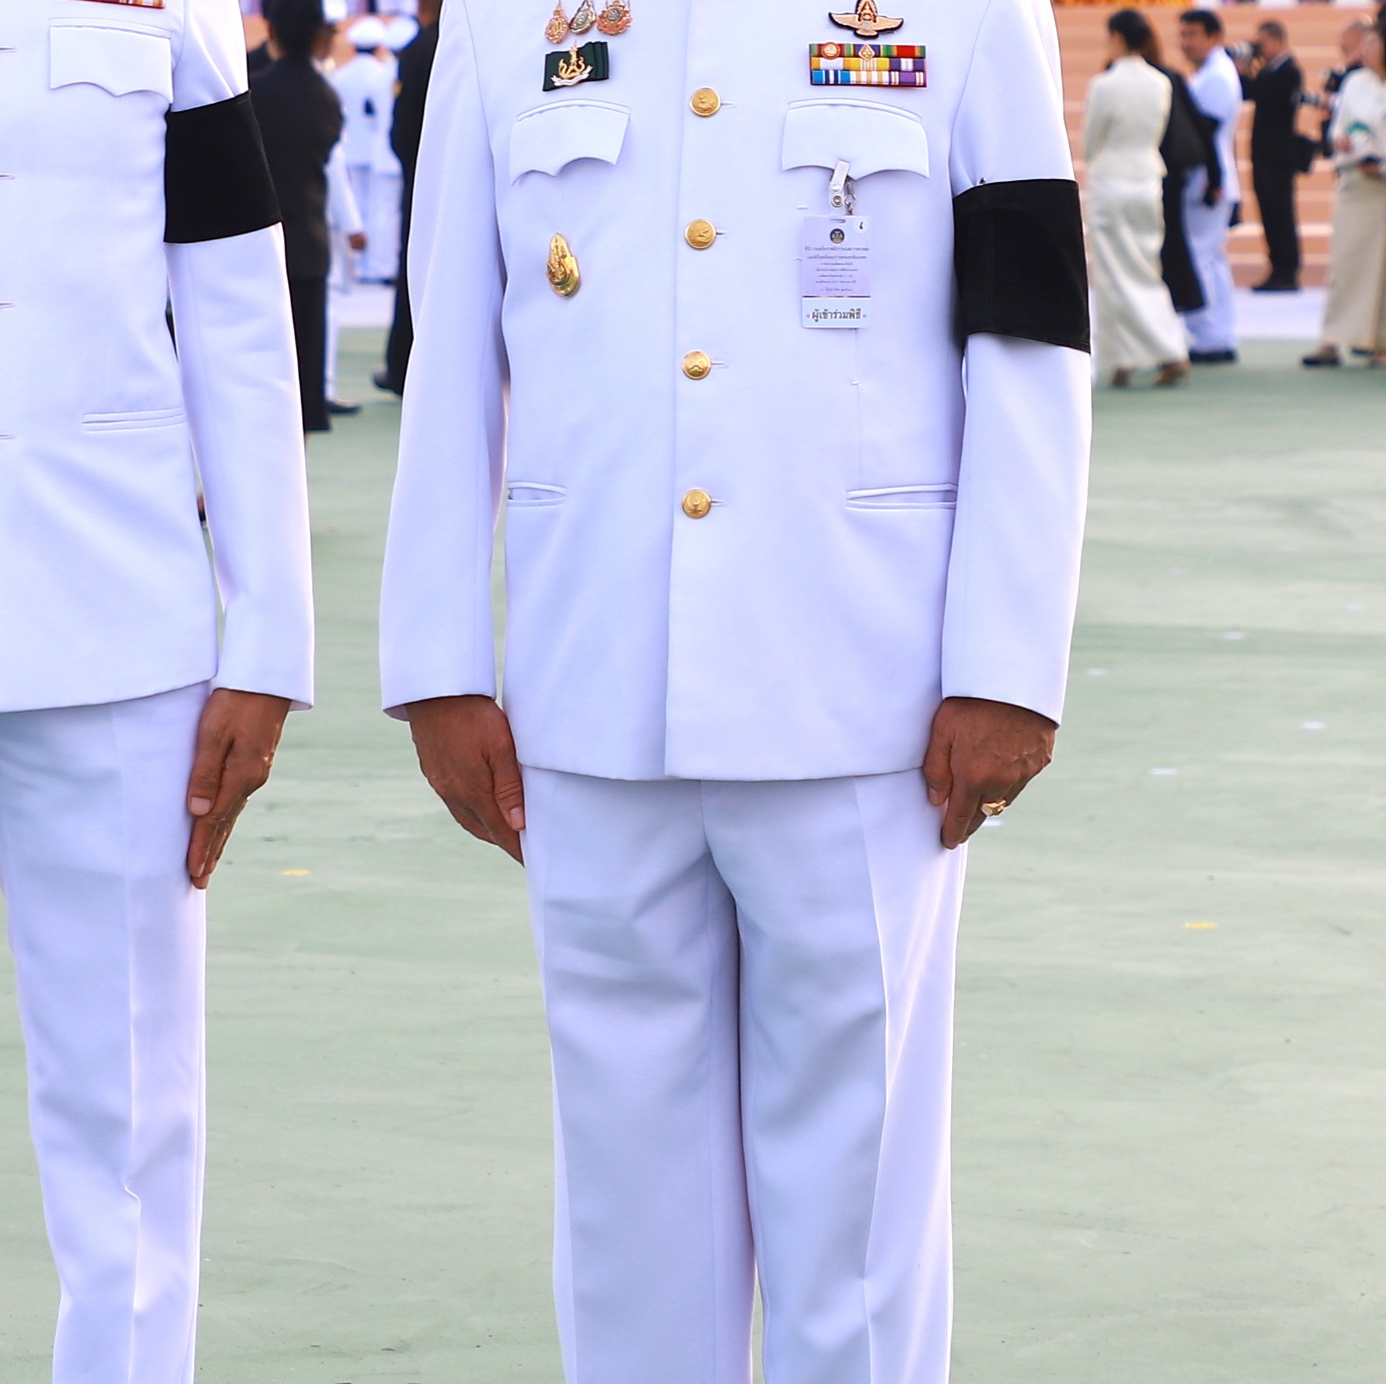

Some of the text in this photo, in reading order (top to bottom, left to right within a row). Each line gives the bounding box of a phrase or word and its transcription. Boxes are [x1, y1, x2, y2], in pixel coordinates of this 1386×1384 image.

[812, 308, 861, 322] ผู้เข้าร่วมพิธี
